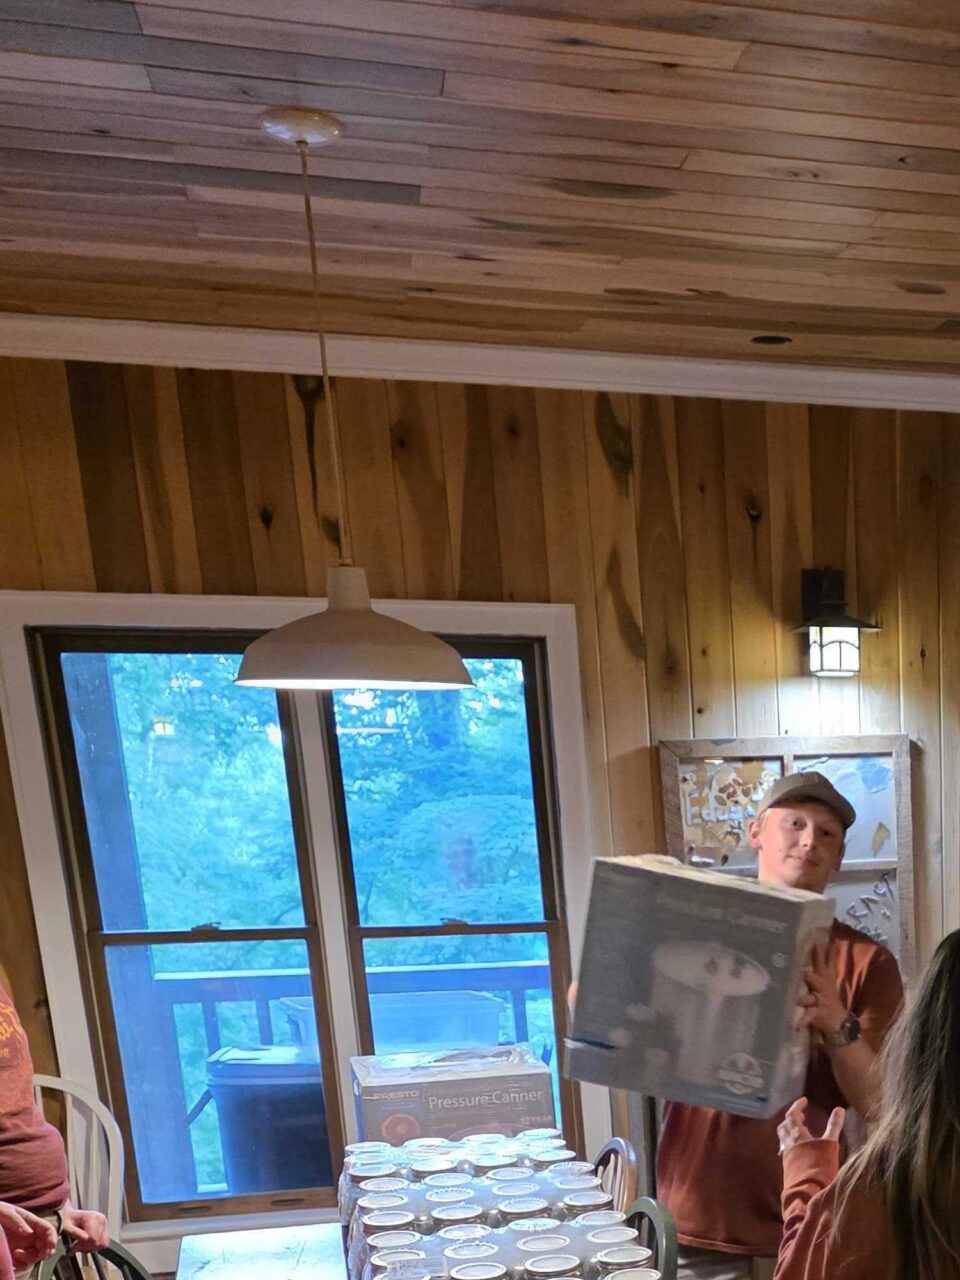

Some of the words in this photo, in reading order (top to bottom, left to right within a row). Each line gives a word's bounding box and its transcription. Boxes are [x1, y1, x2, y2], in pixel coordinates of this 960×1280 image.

[374, 1090, 420, 1100] PRESTO
[428, 1094, 489, 1110] Pressure
[492, 1090, 542, 1104] Canner
